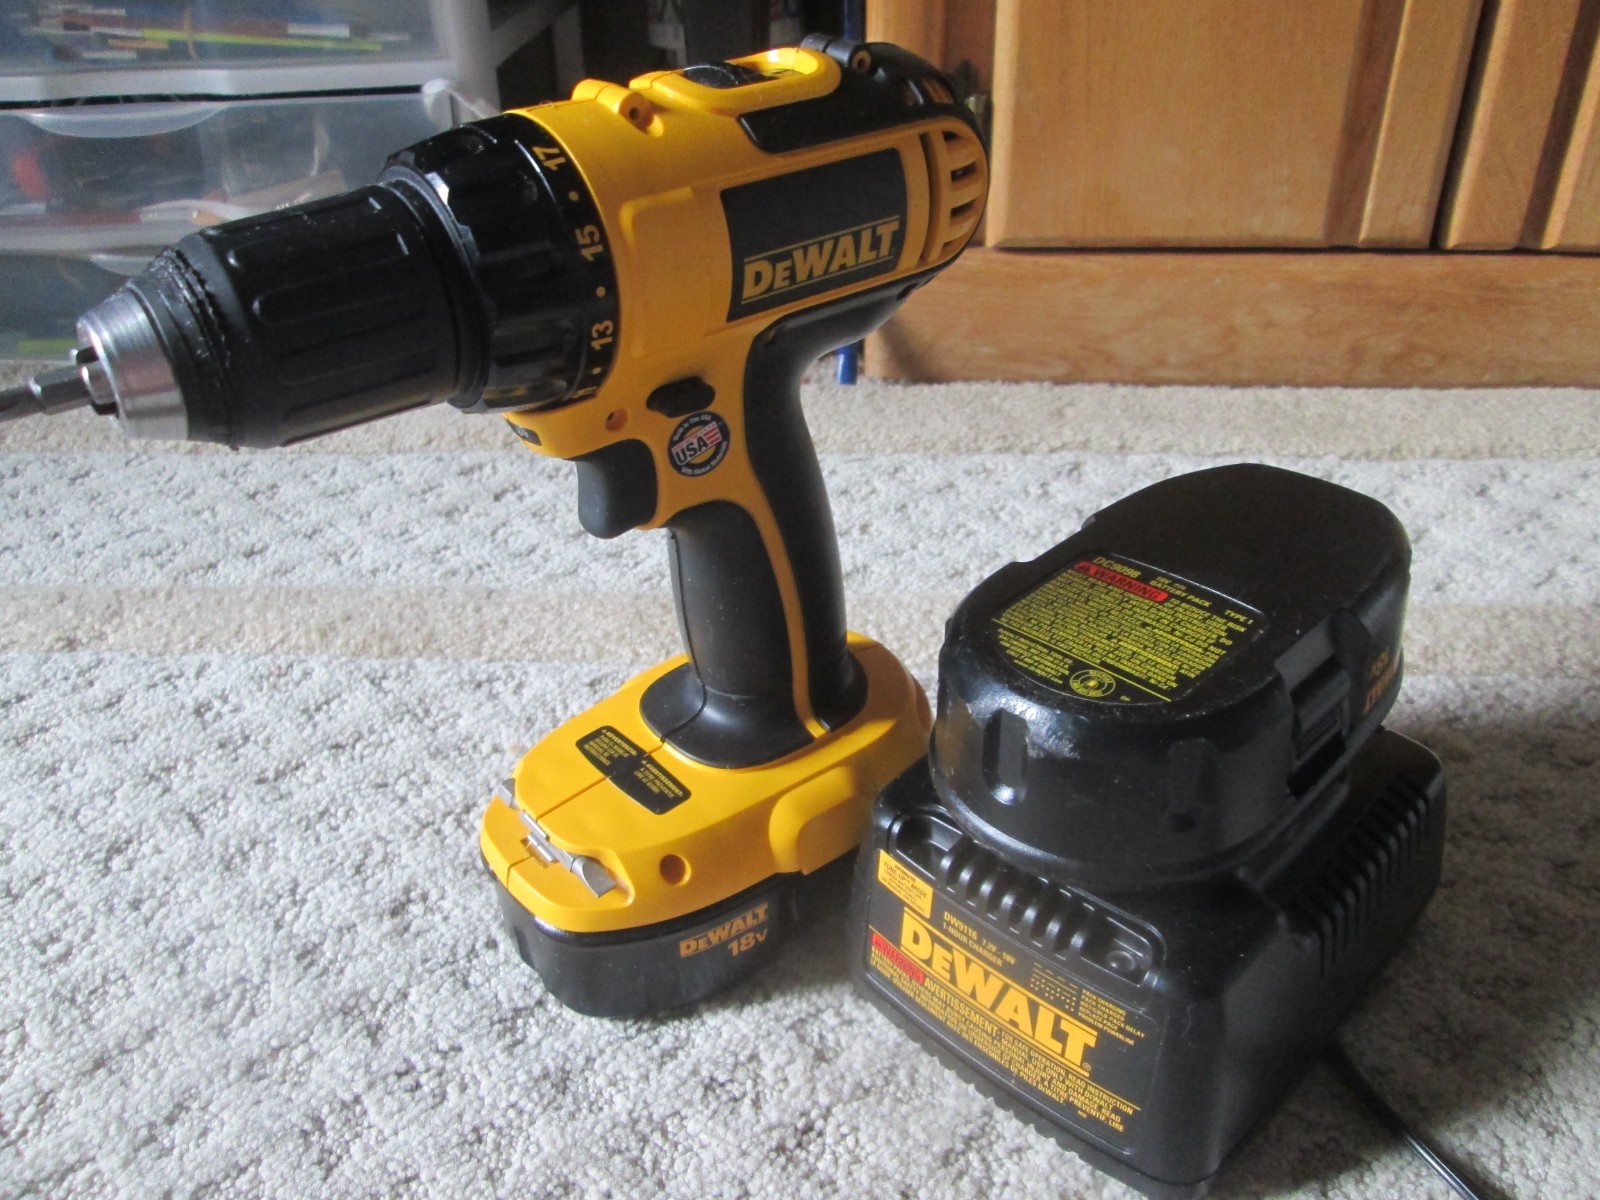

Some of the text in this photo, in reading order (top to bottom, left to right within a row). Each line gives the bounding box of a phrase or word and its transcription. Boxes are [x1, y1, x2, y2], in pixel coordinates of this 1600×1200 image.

[532, 145, 567, 171] 17
[574, 224, 604, 262] 15
[591, 319, 614, 351] 13
[674, 434, 708, 461] USA
[1090, 568, 1164, 600] WARNING
[1167, 597, 1181, 605] TO
[1178, 602, 1212, 617] REDUCE
[1208, 614, 1228, 624] THE
[1184, 594, 1213, 607] PACK
[1221, 609, 1248, 622] TYPE
[1205, 645, 1228, 656] NOT
[1217, 636, 1234, 646] DO
[680, 903, 769, 958] DEWALT
[943, 910, 978, 941] DW9116
[967, 937, 1003, 967] CHARGER
[901, 912, 1098, 1066] DEWALT
[1125, 1023, 1145, 1039] DELAY
[1064, 1077, 1084, 1095] WITH
[1067, 1072, 1086, 1089] READ
[1086, 1084, 1134, 1116] INSTRUCTION
[1100, 1107, 1121, 1124] READ
